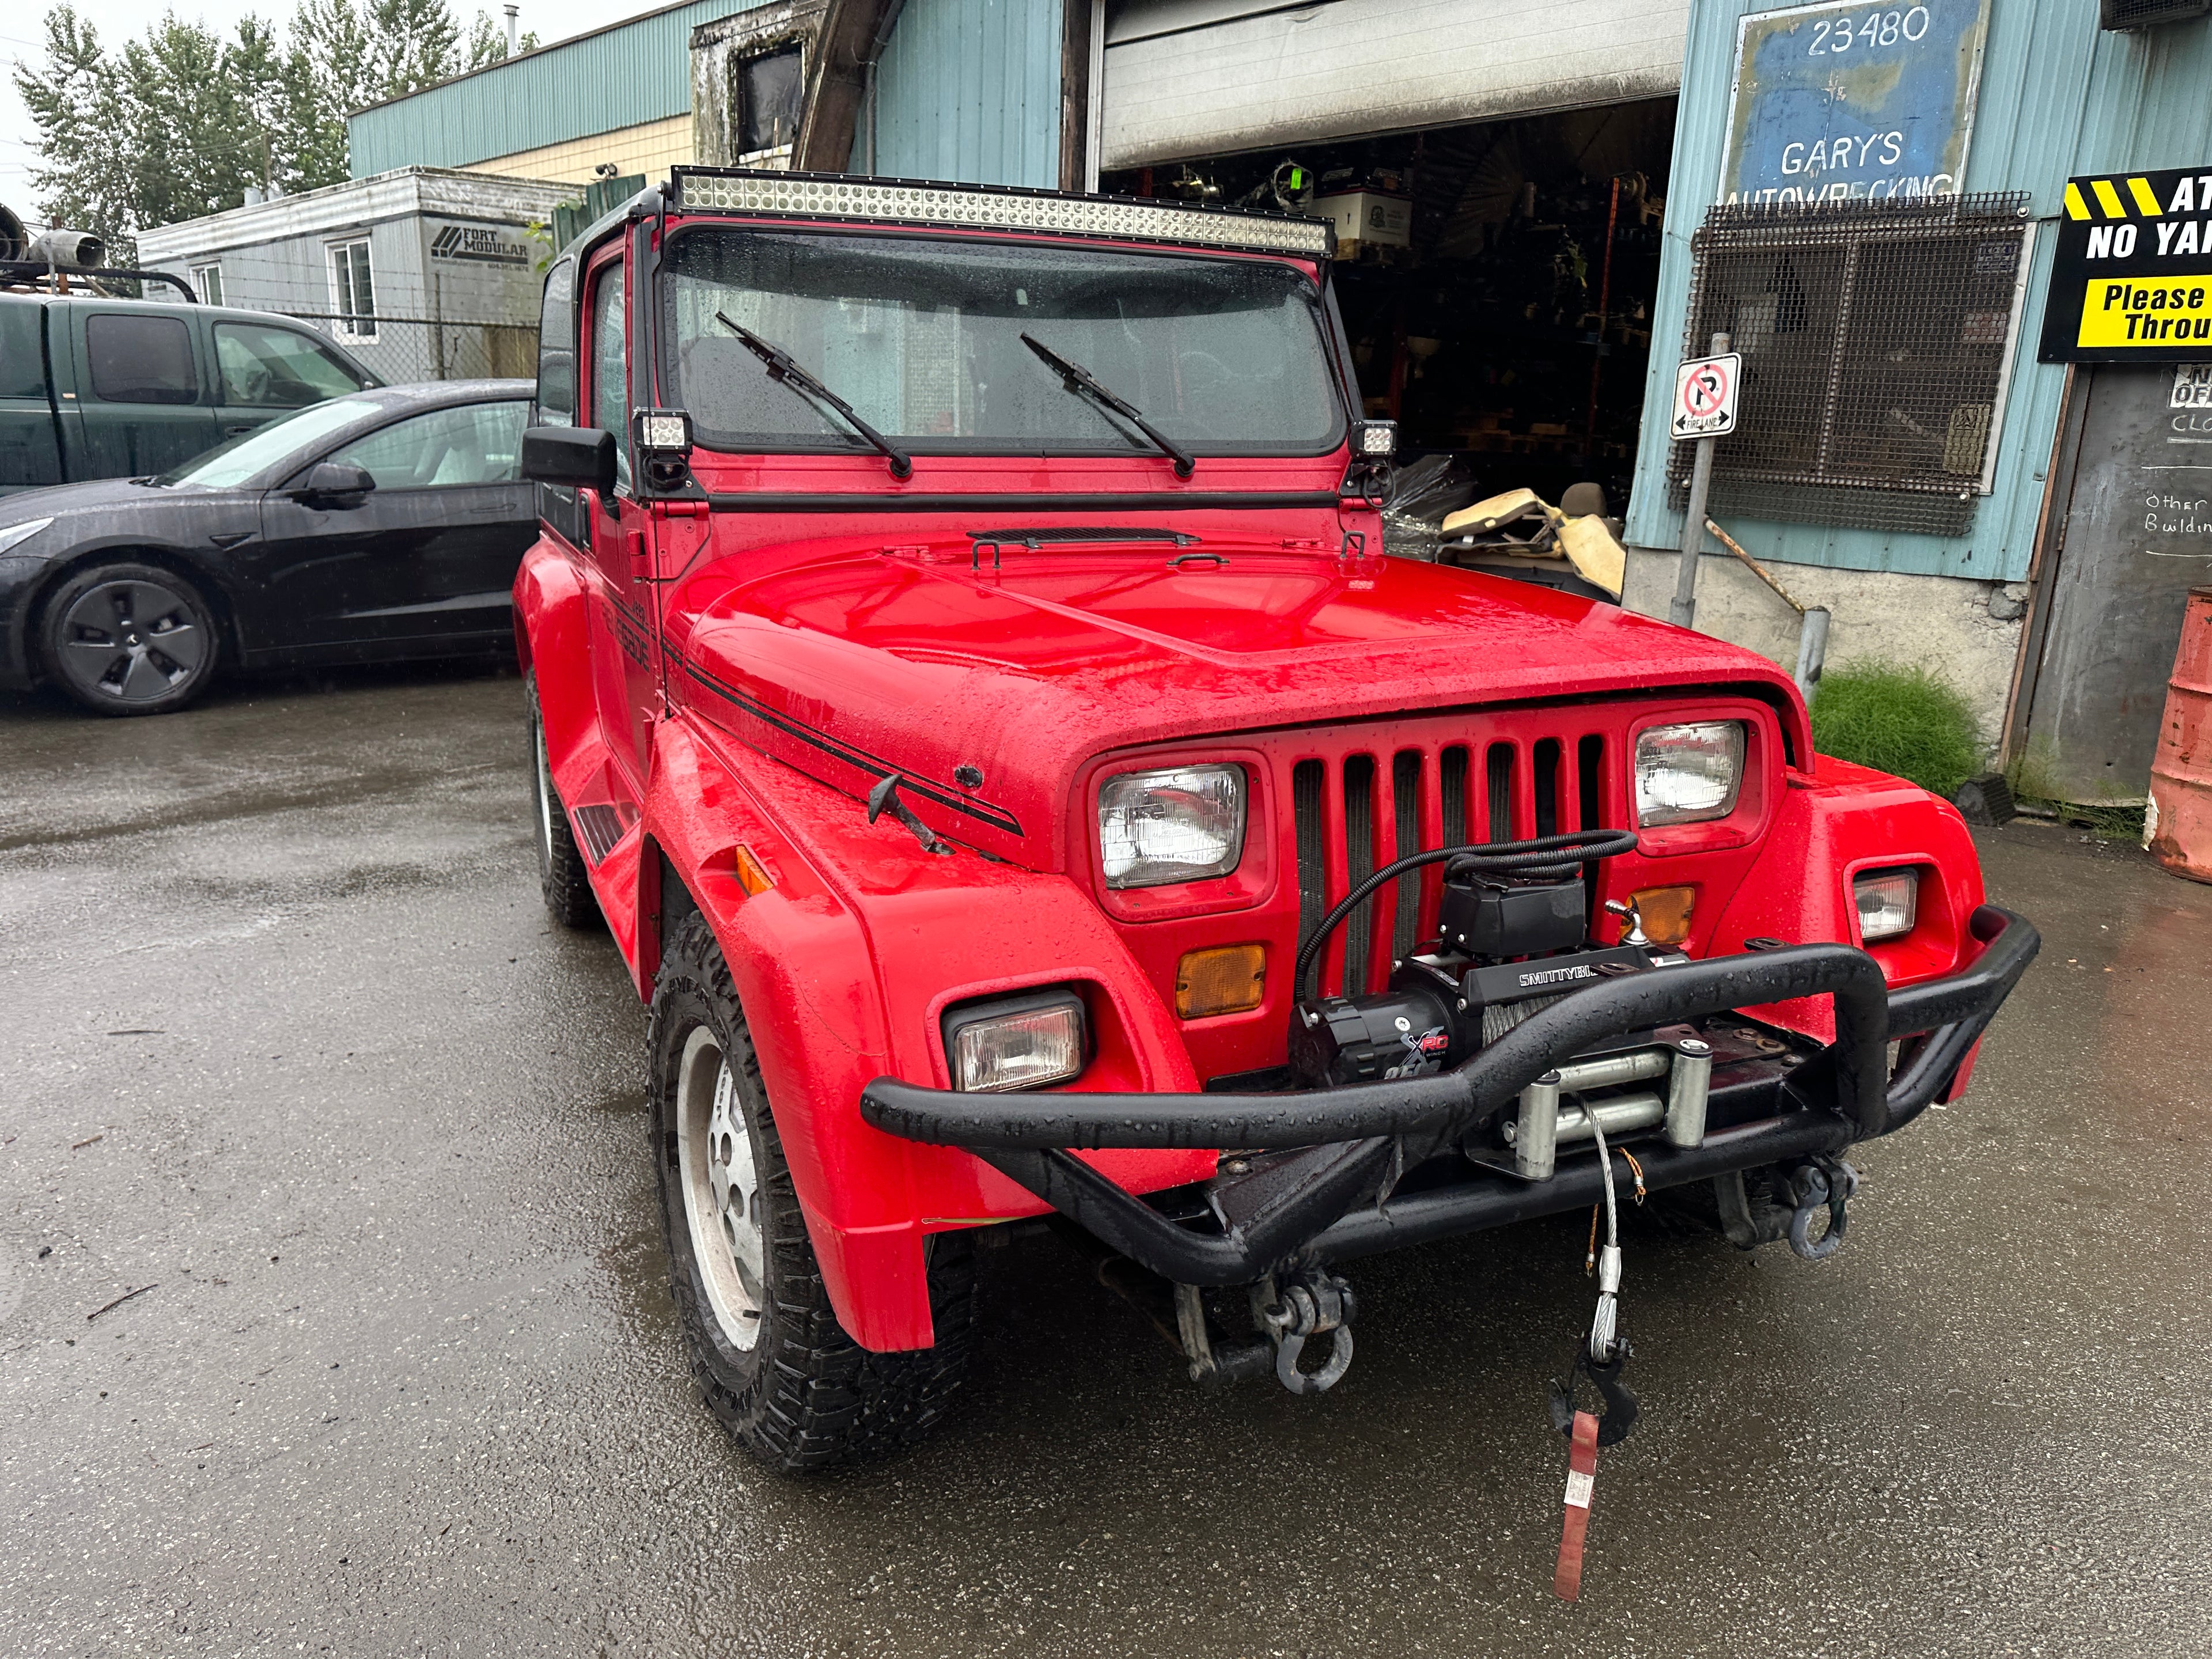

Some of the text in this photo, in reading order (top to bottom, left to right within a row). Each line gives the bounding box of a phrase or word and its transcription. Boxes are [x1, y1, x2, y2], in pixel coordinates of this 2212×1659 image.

[1808, 6, 1930, 56] 23480
[1781, 131, 1903, 175] GARY'S
[463, 228, 497, 241] FORT
[2086, 224, 2138, 259] NO
[464, 240, 528, 256] MODULAR
[2103, 285, 2205, 311] Please
[2125, 313, 2212, 340] Throu
[1687, 419, 1700, 430] FIRE
[1519, 965, 1599, 987] SMITTYBI
